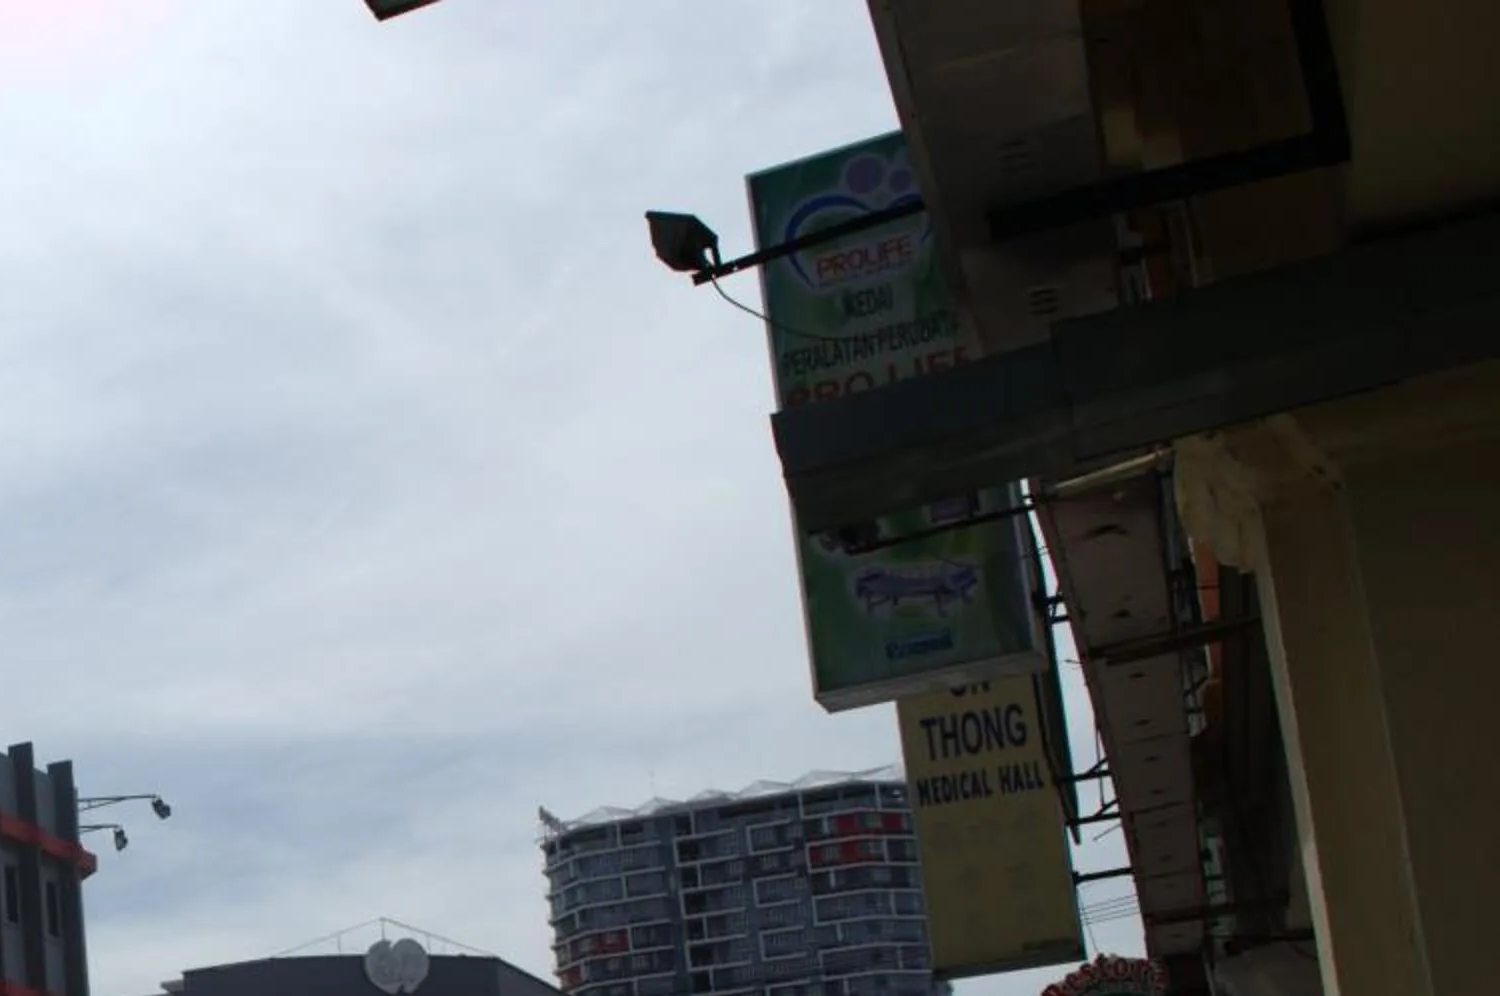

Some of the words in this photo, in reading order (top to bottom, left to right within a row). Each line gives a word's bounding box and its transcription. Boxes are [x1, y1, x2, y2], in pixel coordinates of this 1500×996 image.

[815, 235, 913, 280] PROLIFE
[919, 703, 1028, 762] THONG
[916, 767, 994, 808] MEDICAL
[998, 760, 1046, 797] HALL
